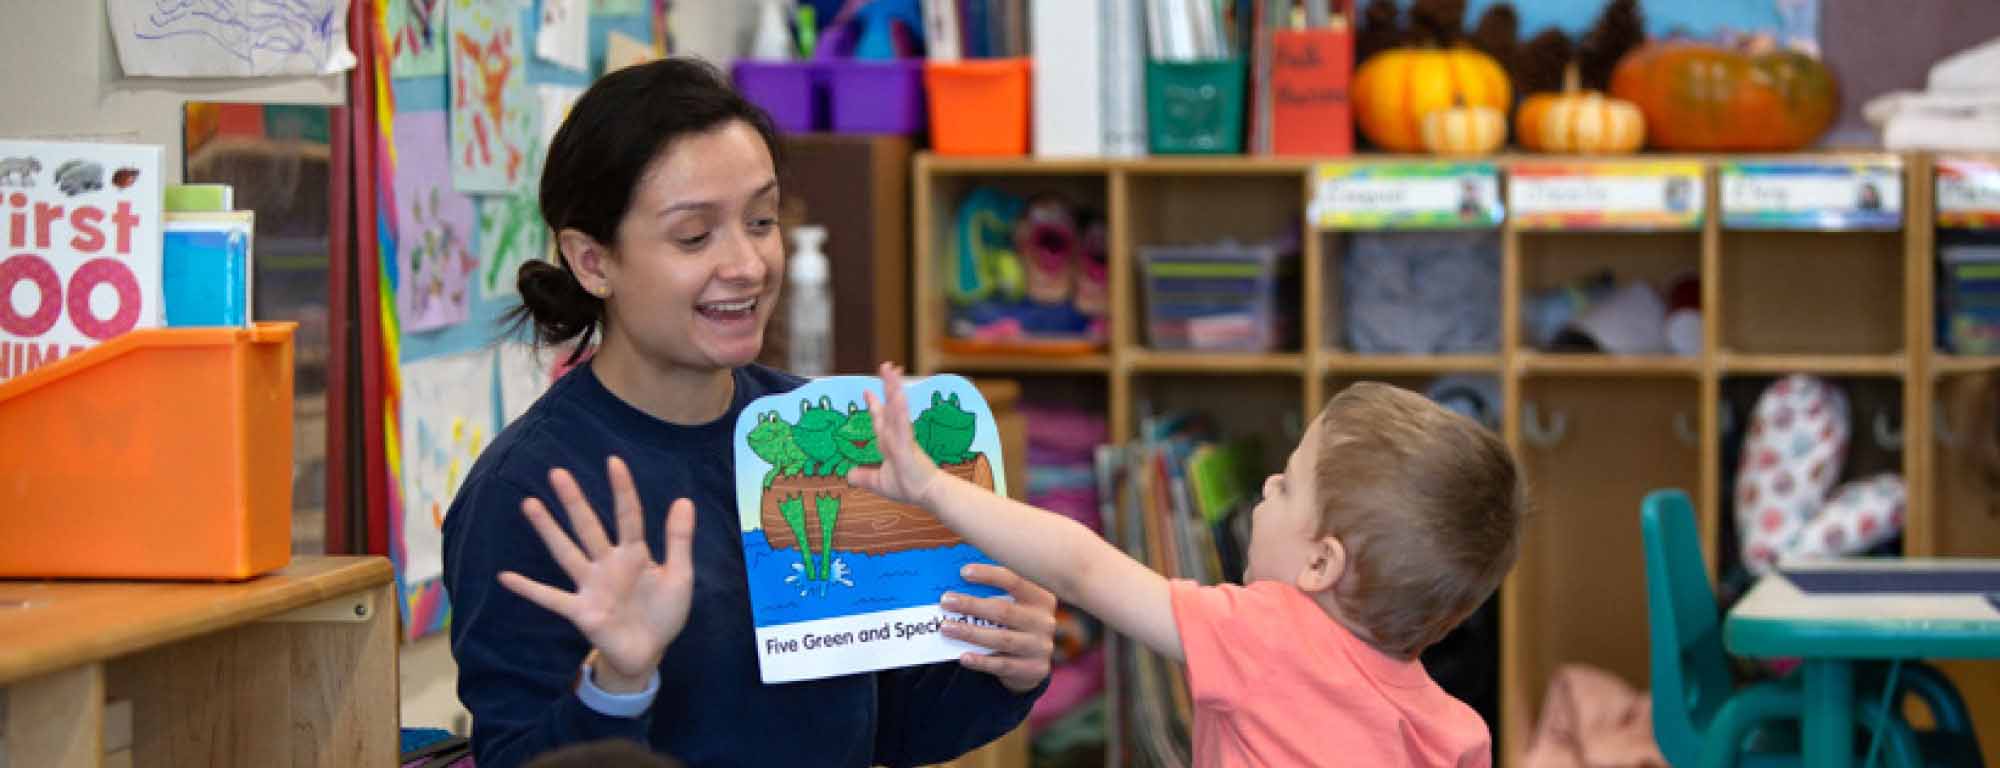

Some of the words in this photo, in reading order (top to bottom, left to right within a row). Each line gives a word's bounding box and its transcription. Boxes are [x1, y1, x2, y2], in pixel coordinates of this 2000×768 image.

[0, 191, 140, 254] irst
[765, 638, 798, 655] Five
[803, 630, 854, 650] Green
[858, 623, 890, 643] and
